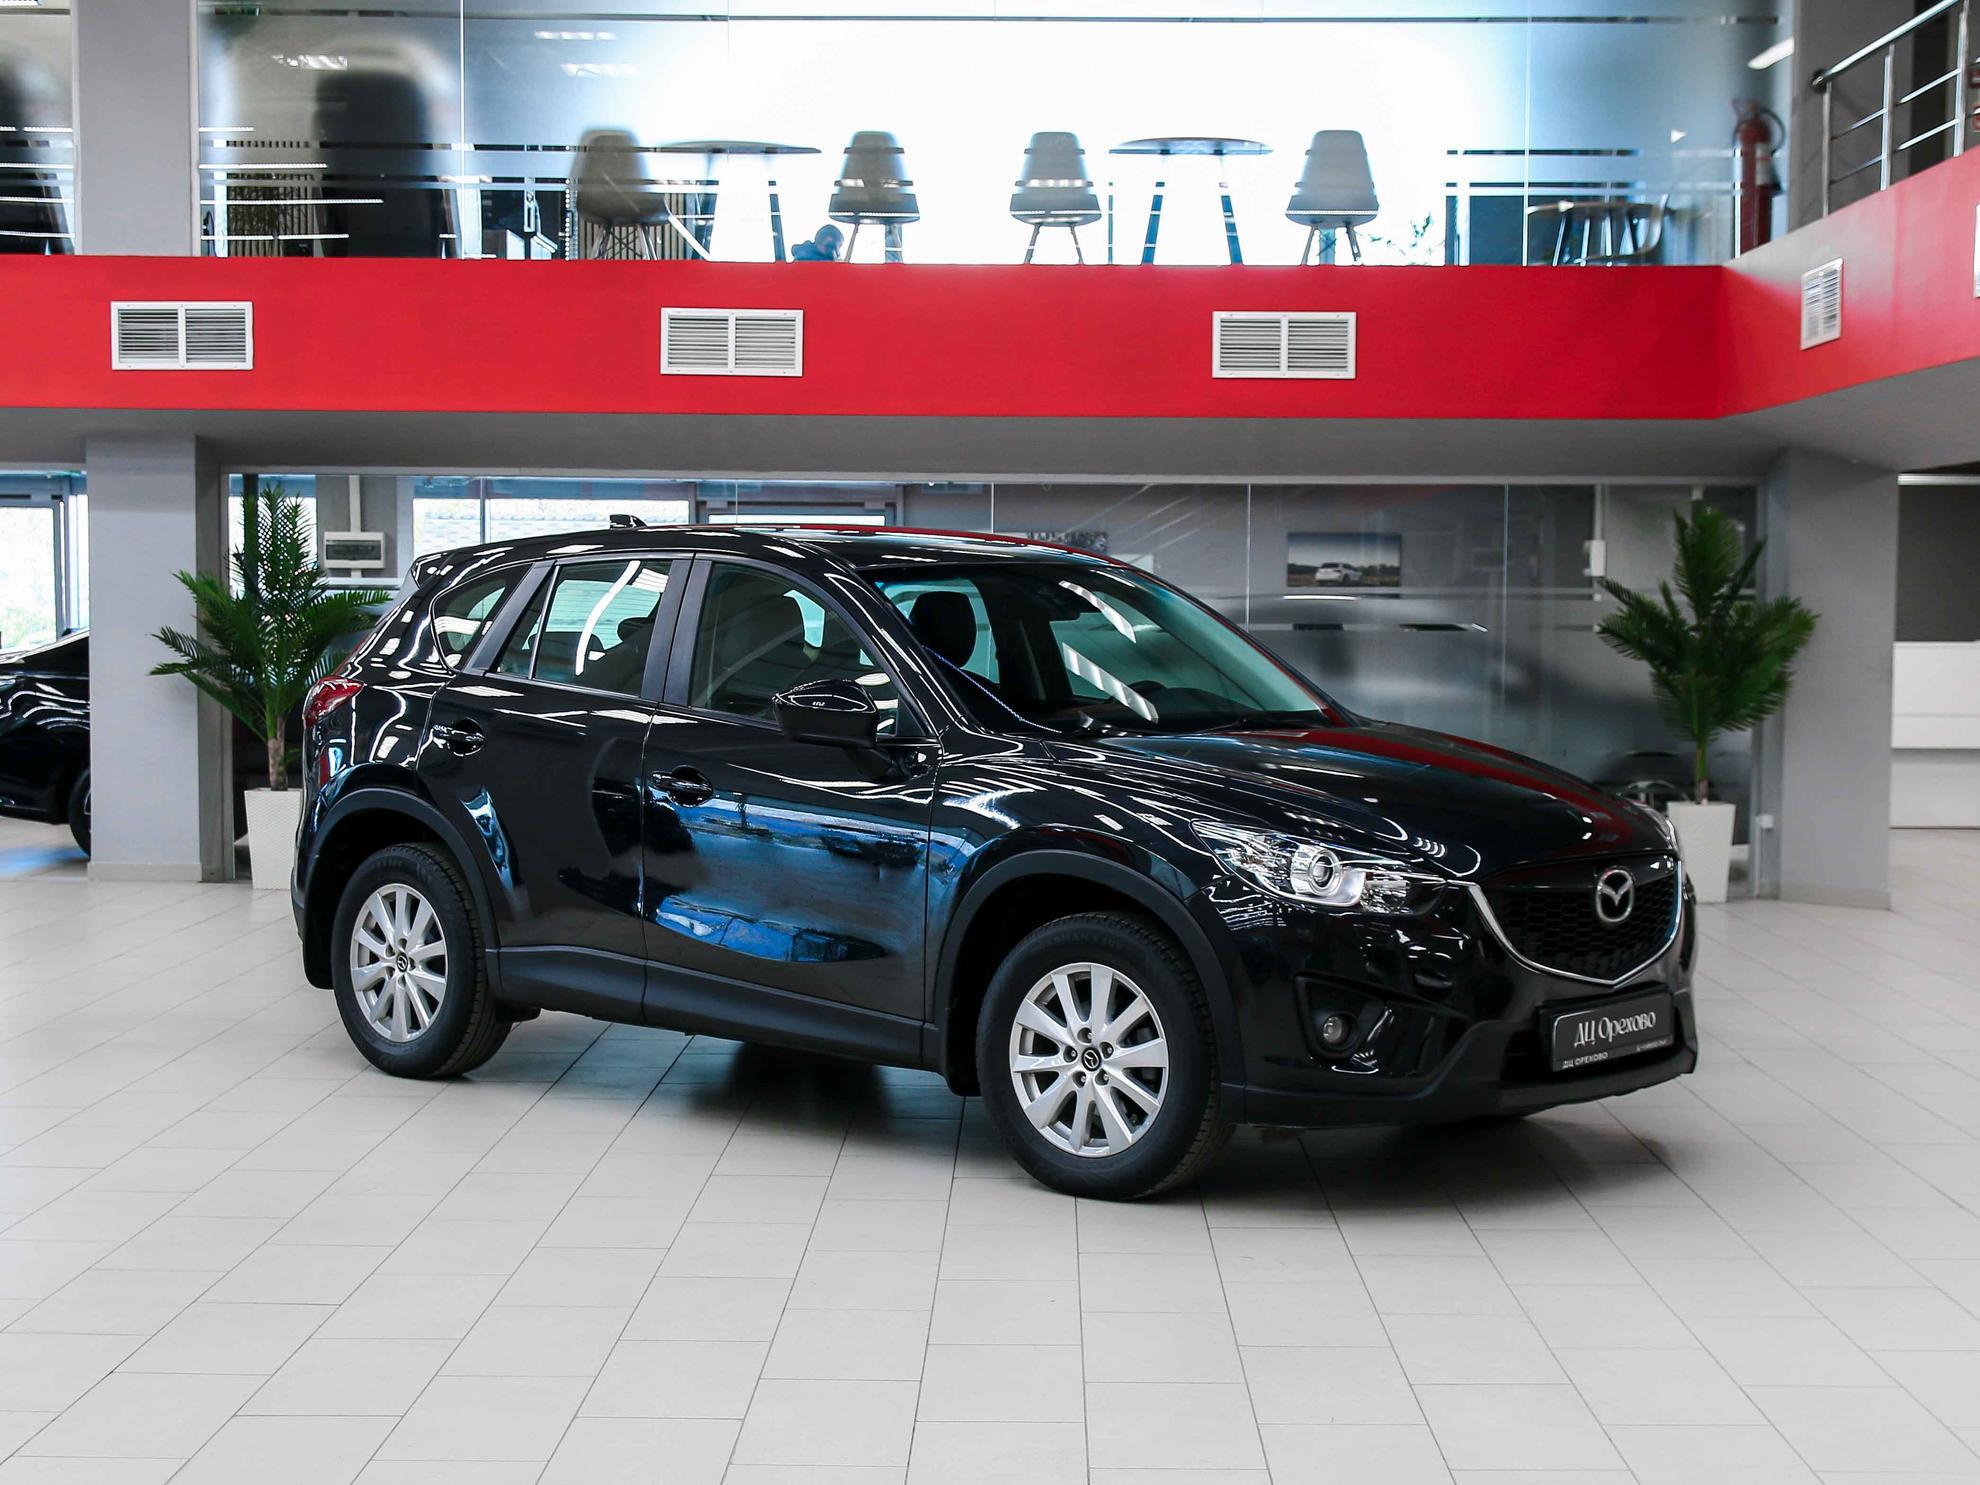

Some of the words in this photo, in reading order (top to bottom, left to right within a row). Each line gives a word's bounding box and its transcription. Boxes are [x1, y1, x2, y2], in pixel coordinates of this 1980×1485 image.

[1574, 1020, 1596, 1048] ДЦ
[1598, 1012, 1656, 1042] Орехово
[1575, 1052, 1608, 1065] ОРЕХОВО
